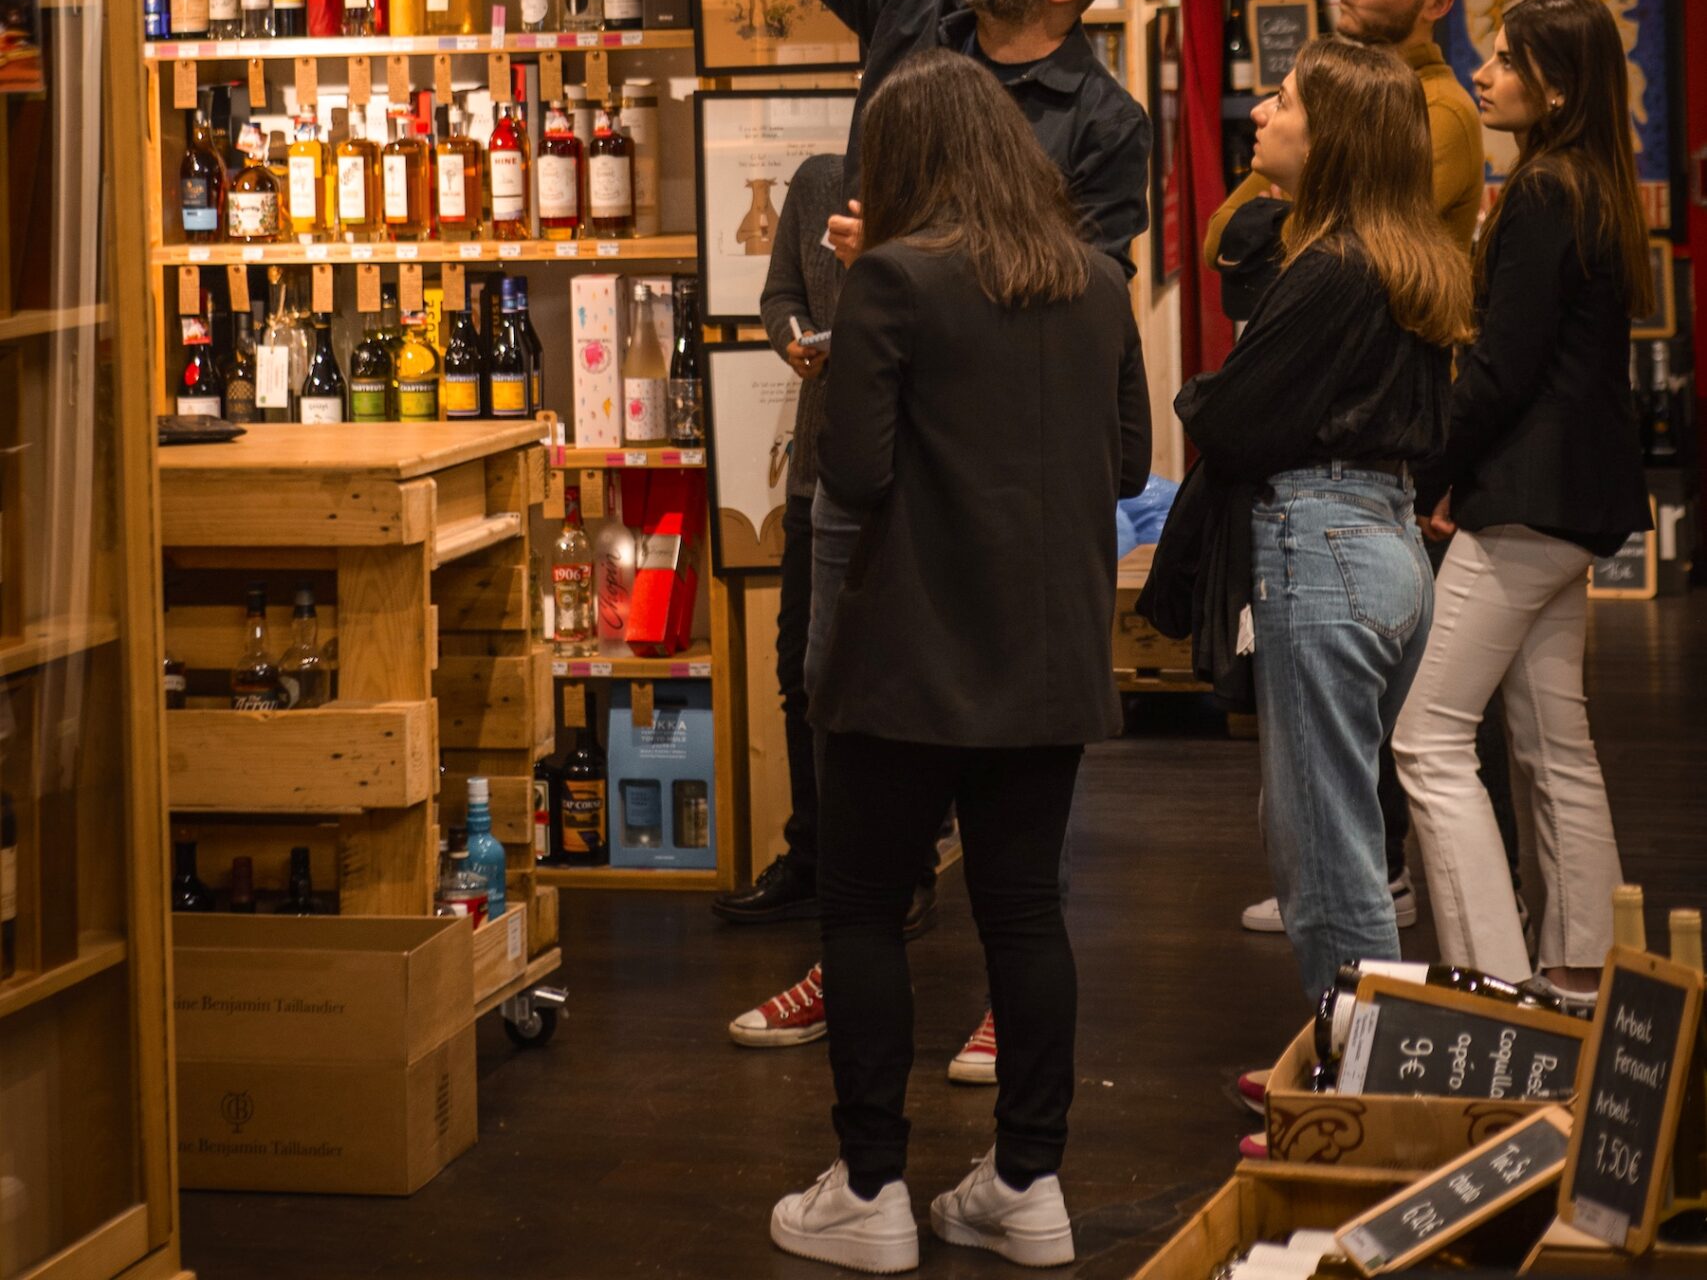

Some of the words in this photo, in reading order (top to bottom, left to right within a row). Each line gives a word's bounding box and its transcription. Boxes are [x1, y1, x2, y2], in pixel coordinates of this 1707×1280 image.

[553, 567, 582, 582] 1906
[201, 994, 271, 1015] Benjamin
[273, 997, 346, 1015] Taillandier
[1448, 1032, 1476, 1092] apéro
[197, 1136, 268, 1158] Benjamin
[270, 1139, 344, 1159] Taillandier
